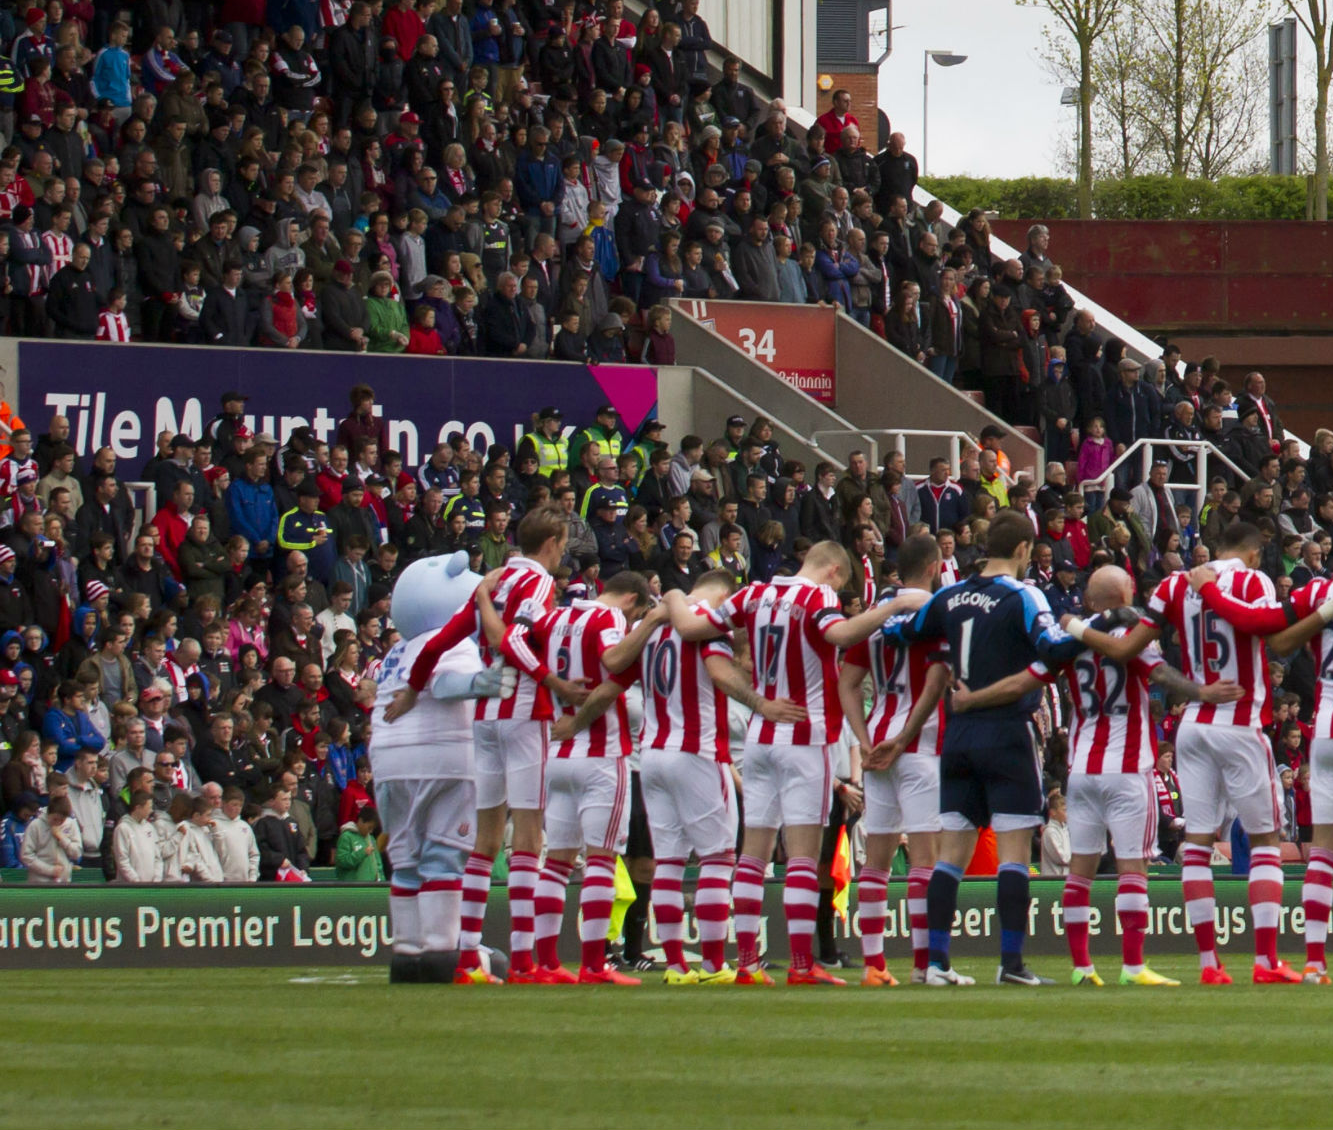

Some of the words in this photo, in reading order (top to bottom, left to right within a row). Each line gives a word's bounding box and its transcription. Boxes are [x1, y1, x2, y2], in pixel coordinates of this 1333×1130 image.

[739, 328, 776, 363] 34
[46, 392, 140, 460] Tile
[643, 639, 677, 698] 10
[758, 624, 785, 686] 17
[960, 617, 975, 680] 1
[1191, 609, 1230, 673] 15
[1074, 658, 1130, 718] 32
[137, 906, 280, 948] Premier
[294, 906, 393, 958] Leagu
